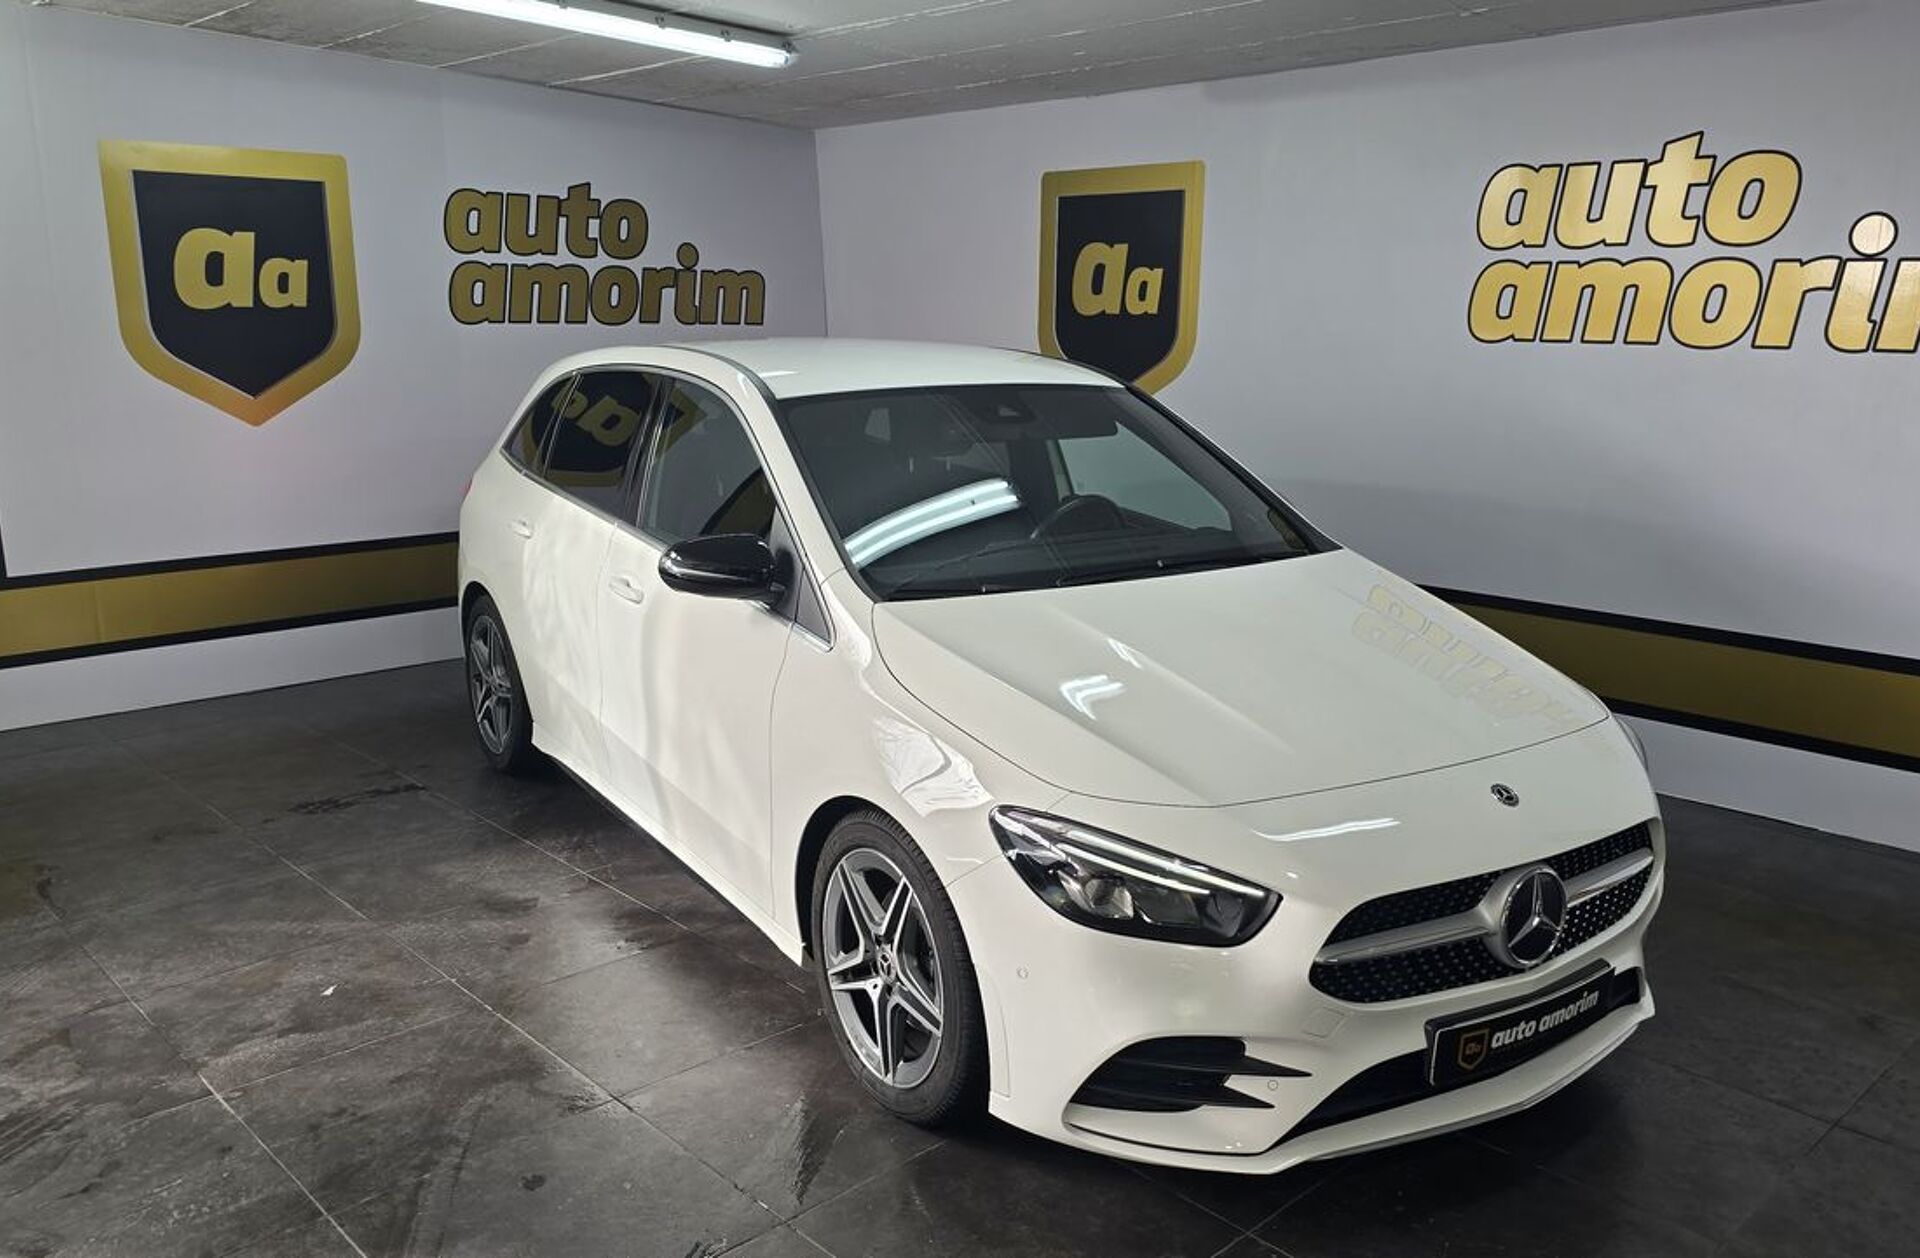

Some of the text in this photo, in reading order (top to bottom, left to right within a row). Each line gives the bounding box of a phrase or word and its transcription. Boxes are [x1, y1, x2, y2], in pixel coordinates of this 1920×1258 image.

[444, 182, 648, 259] auto
[1477, 131, 1801, 250] auto
[174, 228, 308, 309] aa
[450, 242, 765, 325] amorim
[1071, 240, 1163, 316] aa
[1491, 991, 1599, 1048] auto amorim
